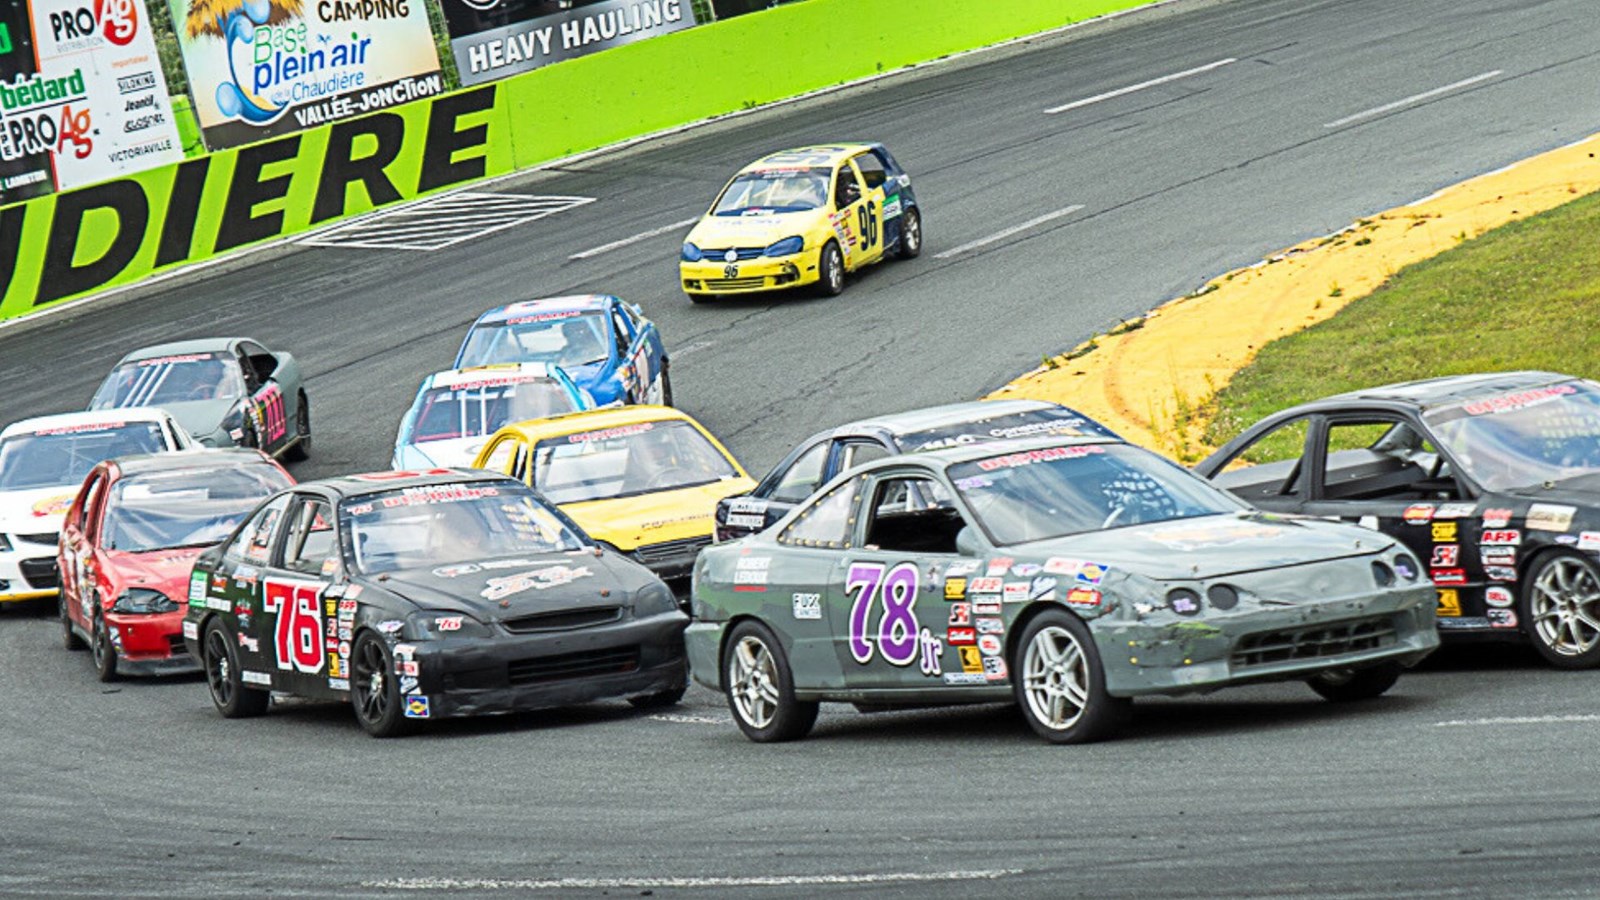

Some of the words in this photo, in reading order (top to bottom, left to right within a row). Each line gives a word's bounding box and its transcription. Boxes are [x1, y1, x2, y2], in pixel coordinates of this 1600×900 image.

[318, 0, 409, 23] CAMPING
[254, 23, 307, 64] Base
[468, 26, 553, 73] HEAVY
[561, 0, 682, 50] HAULING
[253, 47, 325, 95] plein
[331, 31, 371, 68] air
[0, 68, 85, 110] bédard
[291, 71, 364, 102] Chaudière
[108, 139, 171, 163] VICTORIAVILLE
[0, 82, 497, 308] DIERE
[858, 200, 877, 251] 96
[723, 264, 738, 278] 96
[1483, 531, 1519, 543] ARP
[264, 577, 329, 673] 76
[845, 562, 920, 665] 78
[920, 627, 943, 677] jr
